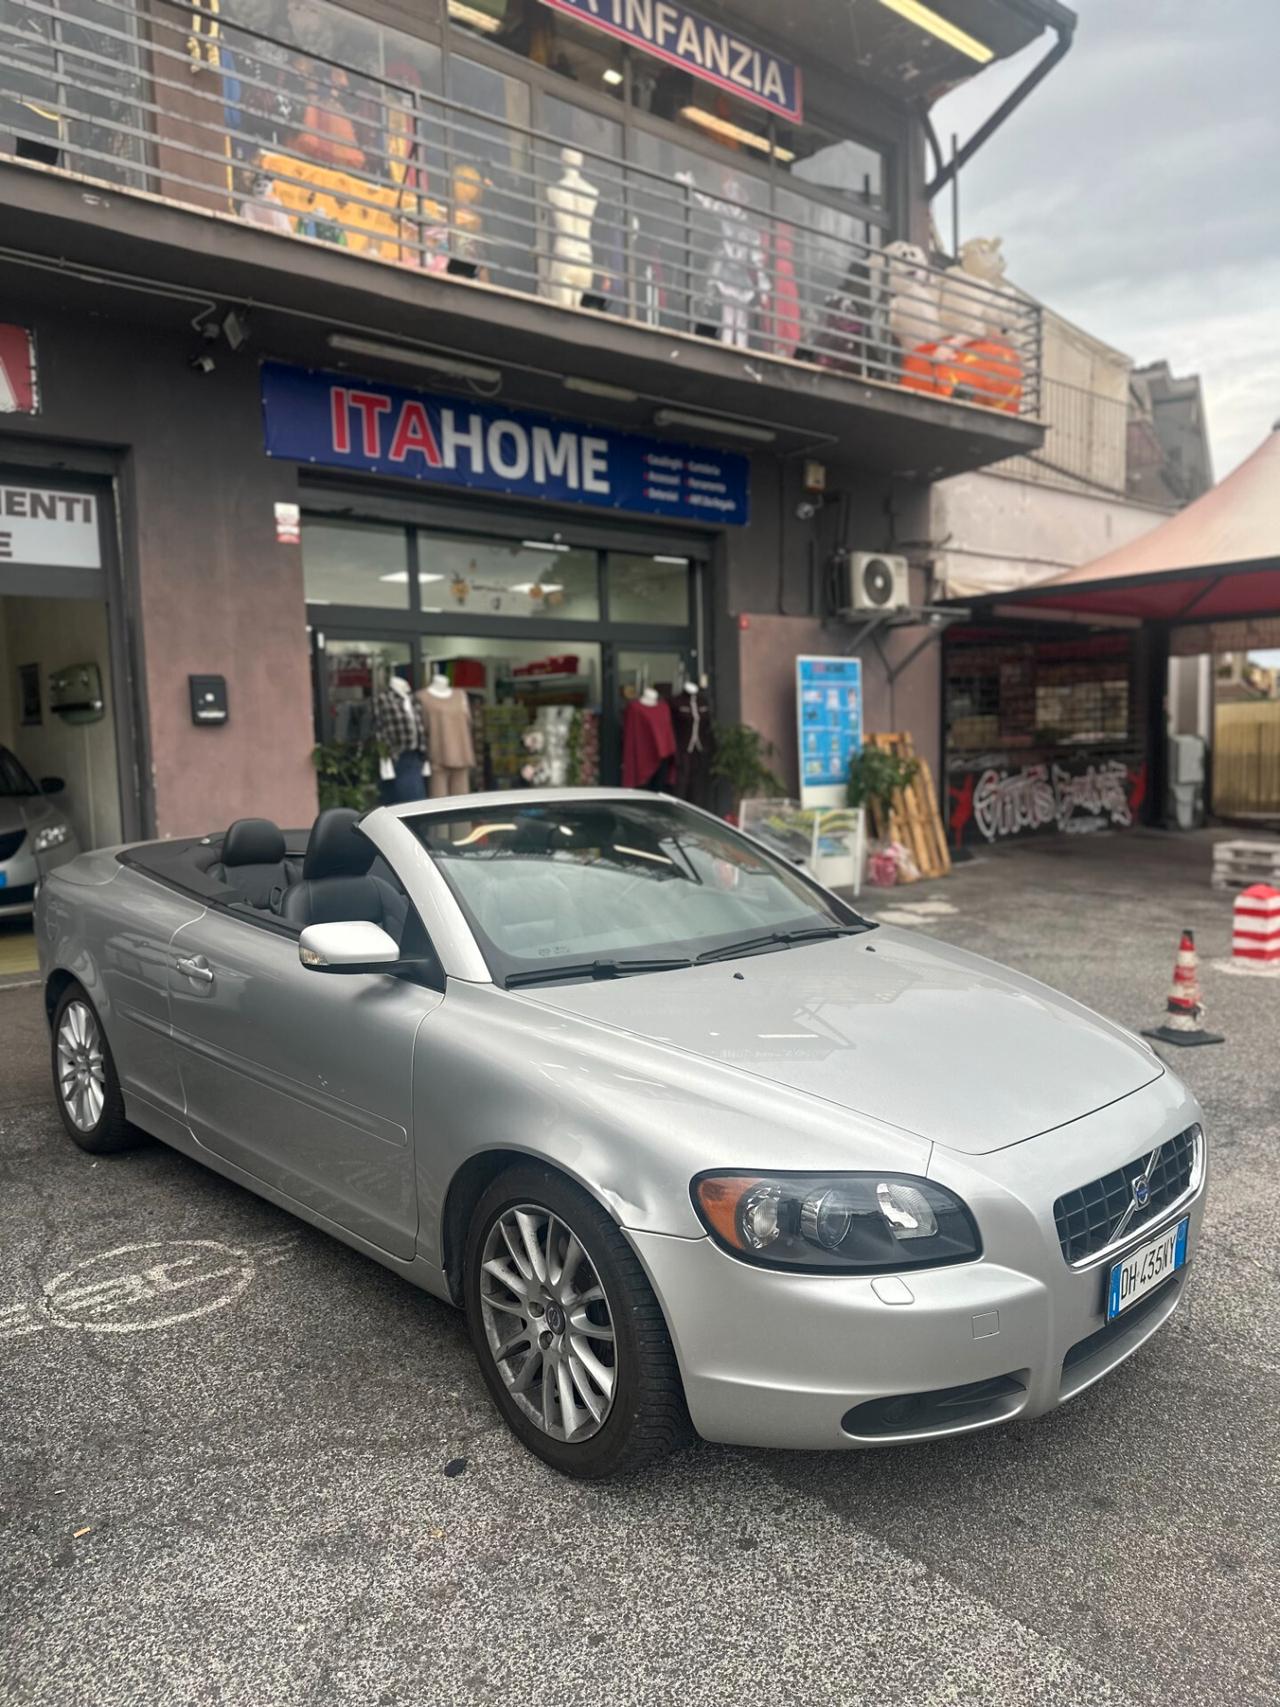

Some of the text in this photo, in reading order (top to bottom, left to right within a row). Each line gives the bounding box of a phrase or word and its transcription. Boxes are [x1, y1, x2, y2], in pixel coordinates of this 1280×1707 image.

[612, 0, 787, 105] INFANZIA
[330, 386, 611, 495] ITAHOME
[0, 487, 92, 524] ENTI
